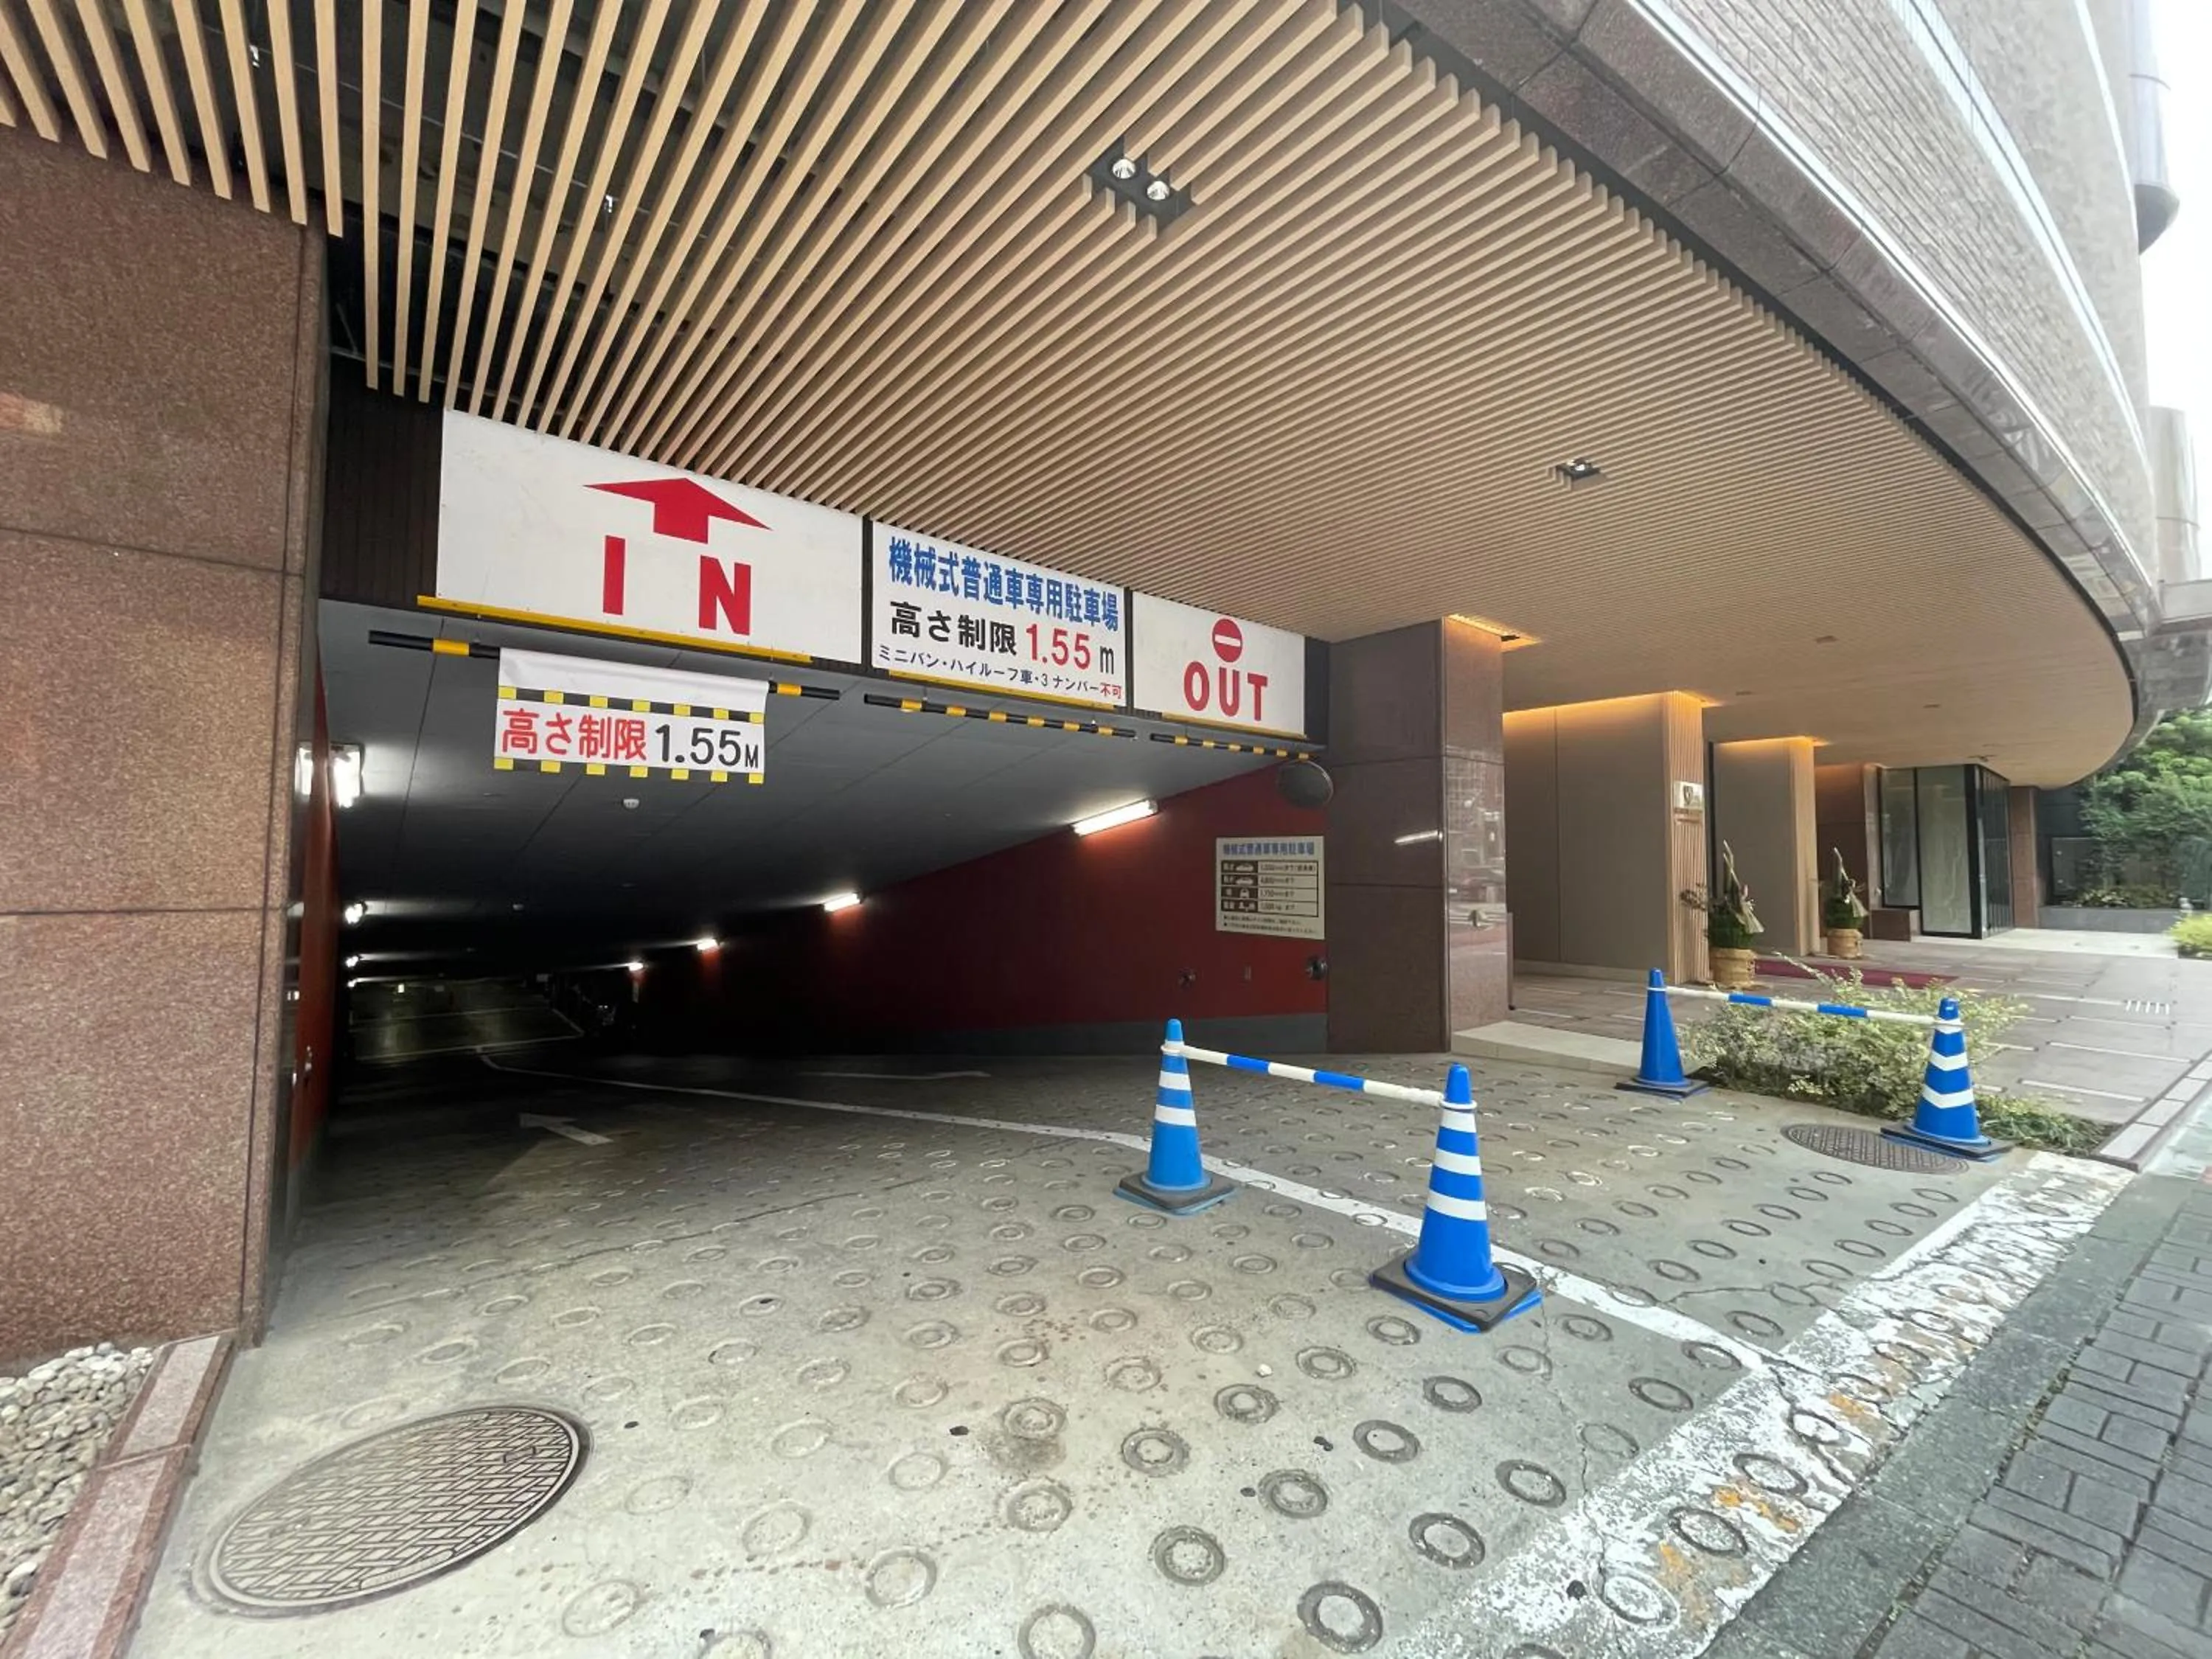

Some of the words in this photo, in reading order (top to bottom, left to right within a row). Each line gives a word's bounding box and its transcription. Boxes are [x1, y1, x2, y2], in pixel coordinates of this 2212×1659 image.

[602, 535, 751, 636] IN
[888, 536, 1119, 632] 機械式普通車専用駐車場
[1183, 661, 1268, 722] OUT
